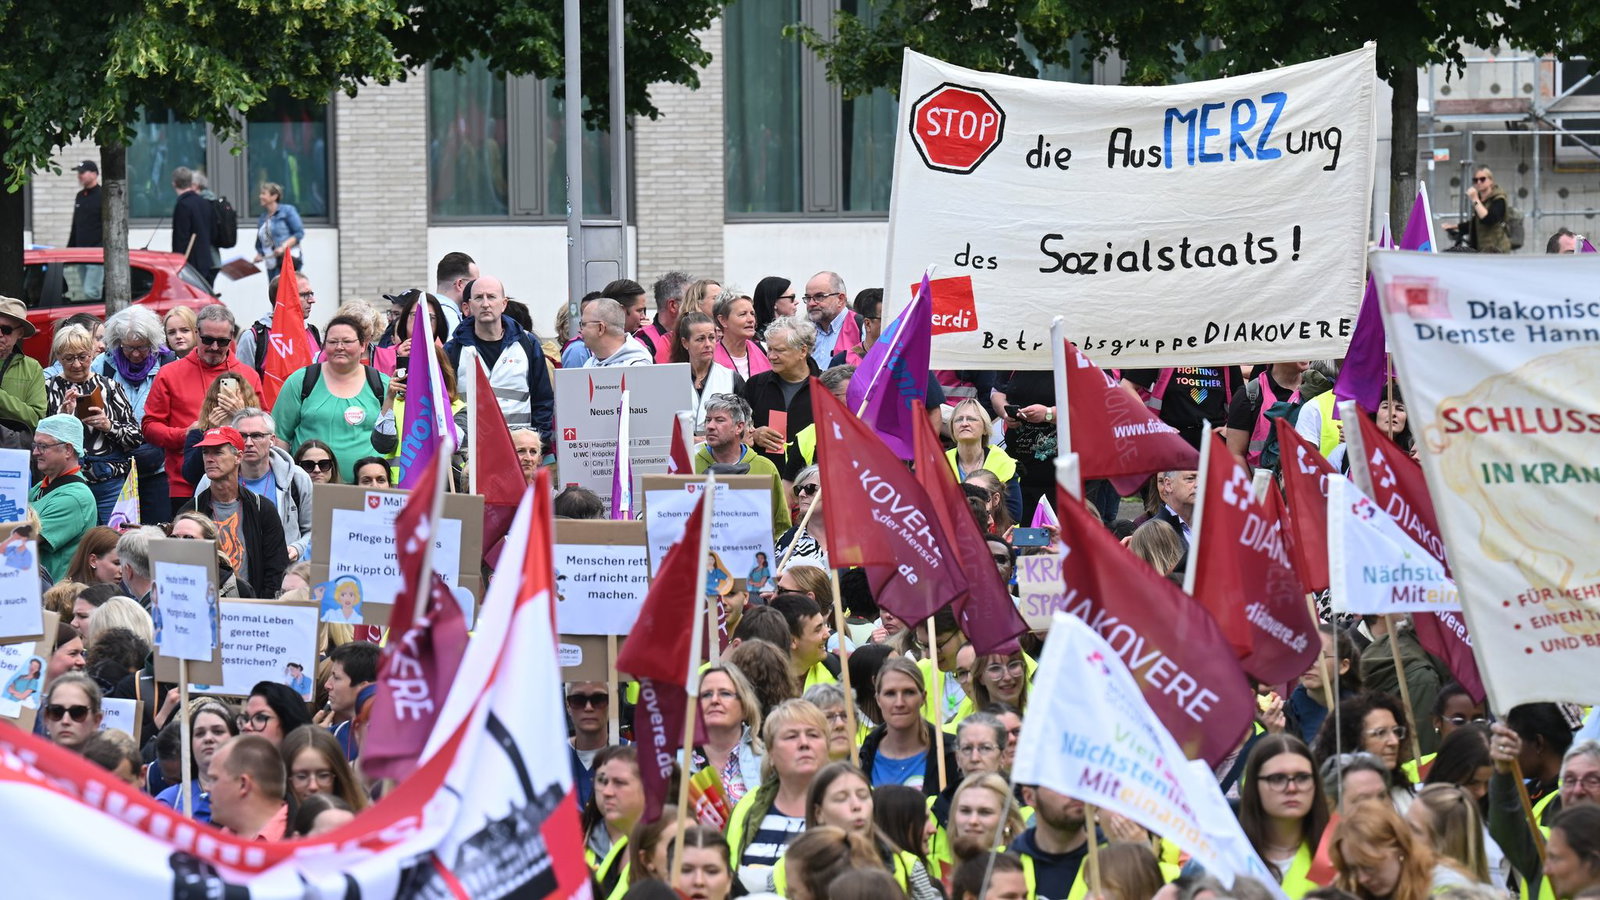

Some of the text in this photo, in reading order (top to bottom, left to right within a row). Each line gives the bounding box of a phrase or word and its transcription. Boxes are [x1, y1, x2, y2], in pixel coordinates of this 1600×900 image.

[926, 106, 996, 142] STOP
[1025, 92, 1342, 171] die AusMERZung
[954, 244, 998, 270] des
[1467, 296, 1600, 321] Diakonisc
[931, 310, 971, 329] er.di
[982, 317, 1351, 356] Betrbsgruppe DIAKOVERE
[1414, 323, 1600, 344] Dienste Hann
[1177, 367, 1219, 377] FIGHTING
[1176, 377, 1222, 388] TOGETHER
[590, 408, 614, 416] Neues
[1442, 407, 1600, 434] SCHLUSS
[632, 457, 667, 465] Information
[593, 468, 613, 476] KUBUS
[1481, 463, 1600, 484] IN KRAN
[349, 532, 382, 545] Pflege
[722, 544, 762, 553] gesessen?
[899, 528, 940, 568] Mensch
[566, 555, 648, 566] Menschen rett
[337, 563, 351, 572] ihr
[354, 564, 381, 577] kippt
[383, 566, 395, 576] Öl
[574, 573, 597, 582] darf
[600, 573, 628, 583] nicht
[588, 590, 638, 599] machen.
[1517, 588, 1554, 607] FÜR
[221, 613, 294, 625] hon mal Leben
[1530, 609, 1584, 629] EINEN
[230, 629, 270, 637] gerettet
[256, 644, 286, 655] Pflege
[1541, 637, 1580, 653] UND
